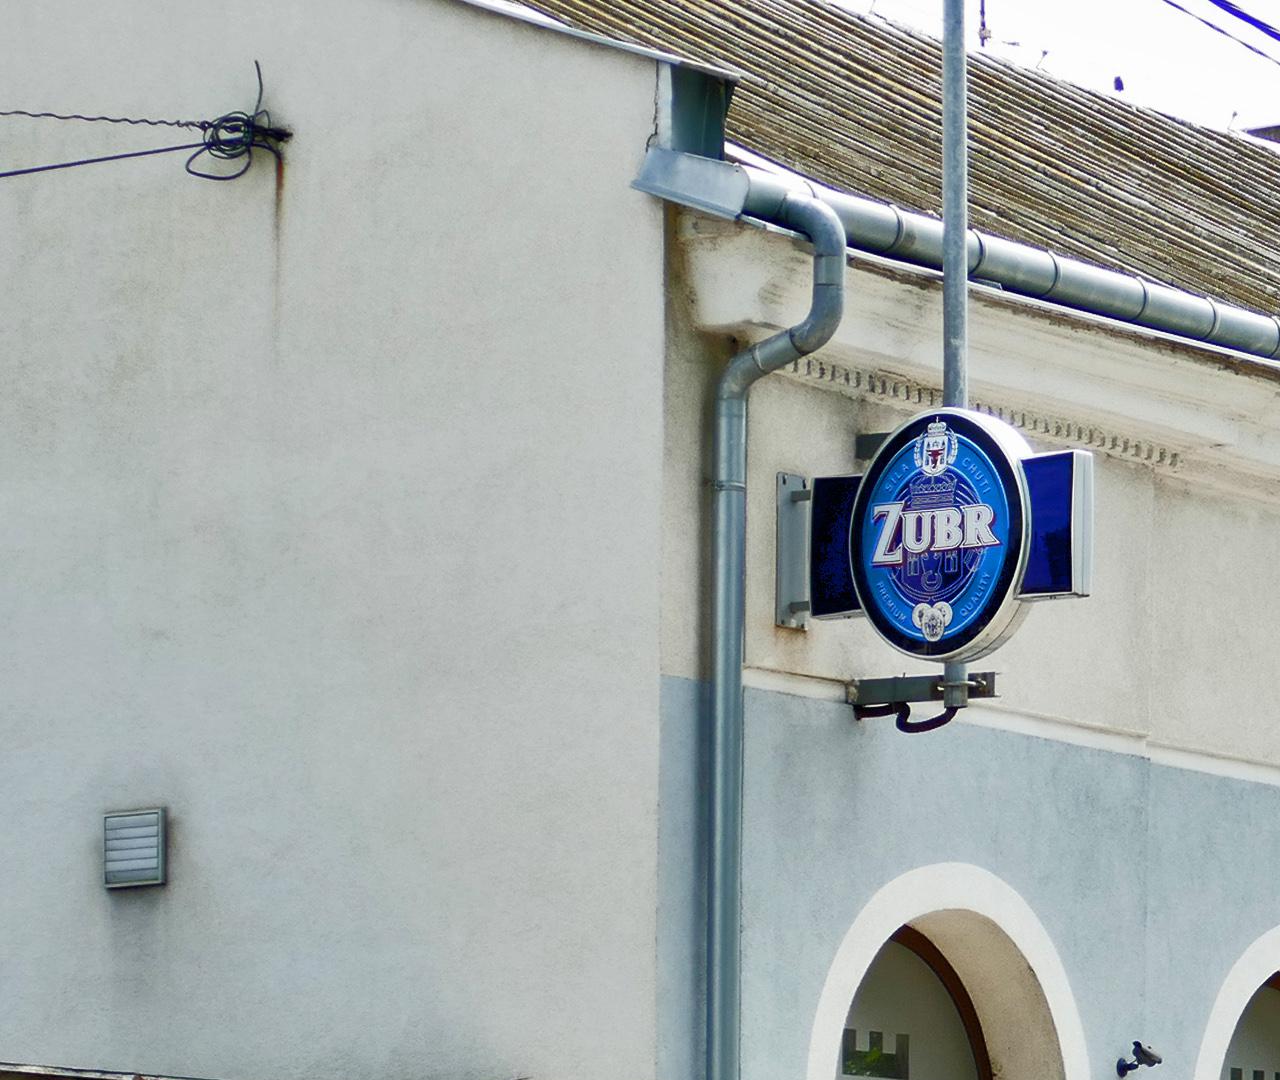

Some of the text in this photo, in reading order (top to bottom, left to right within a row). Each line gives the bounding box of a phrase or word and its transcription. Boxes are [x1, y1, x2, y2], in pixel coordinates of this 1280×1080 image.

[872, 500, 1001, 566] ZUBR
[876, 572, 990, 625] PREMIUM QUALITY
